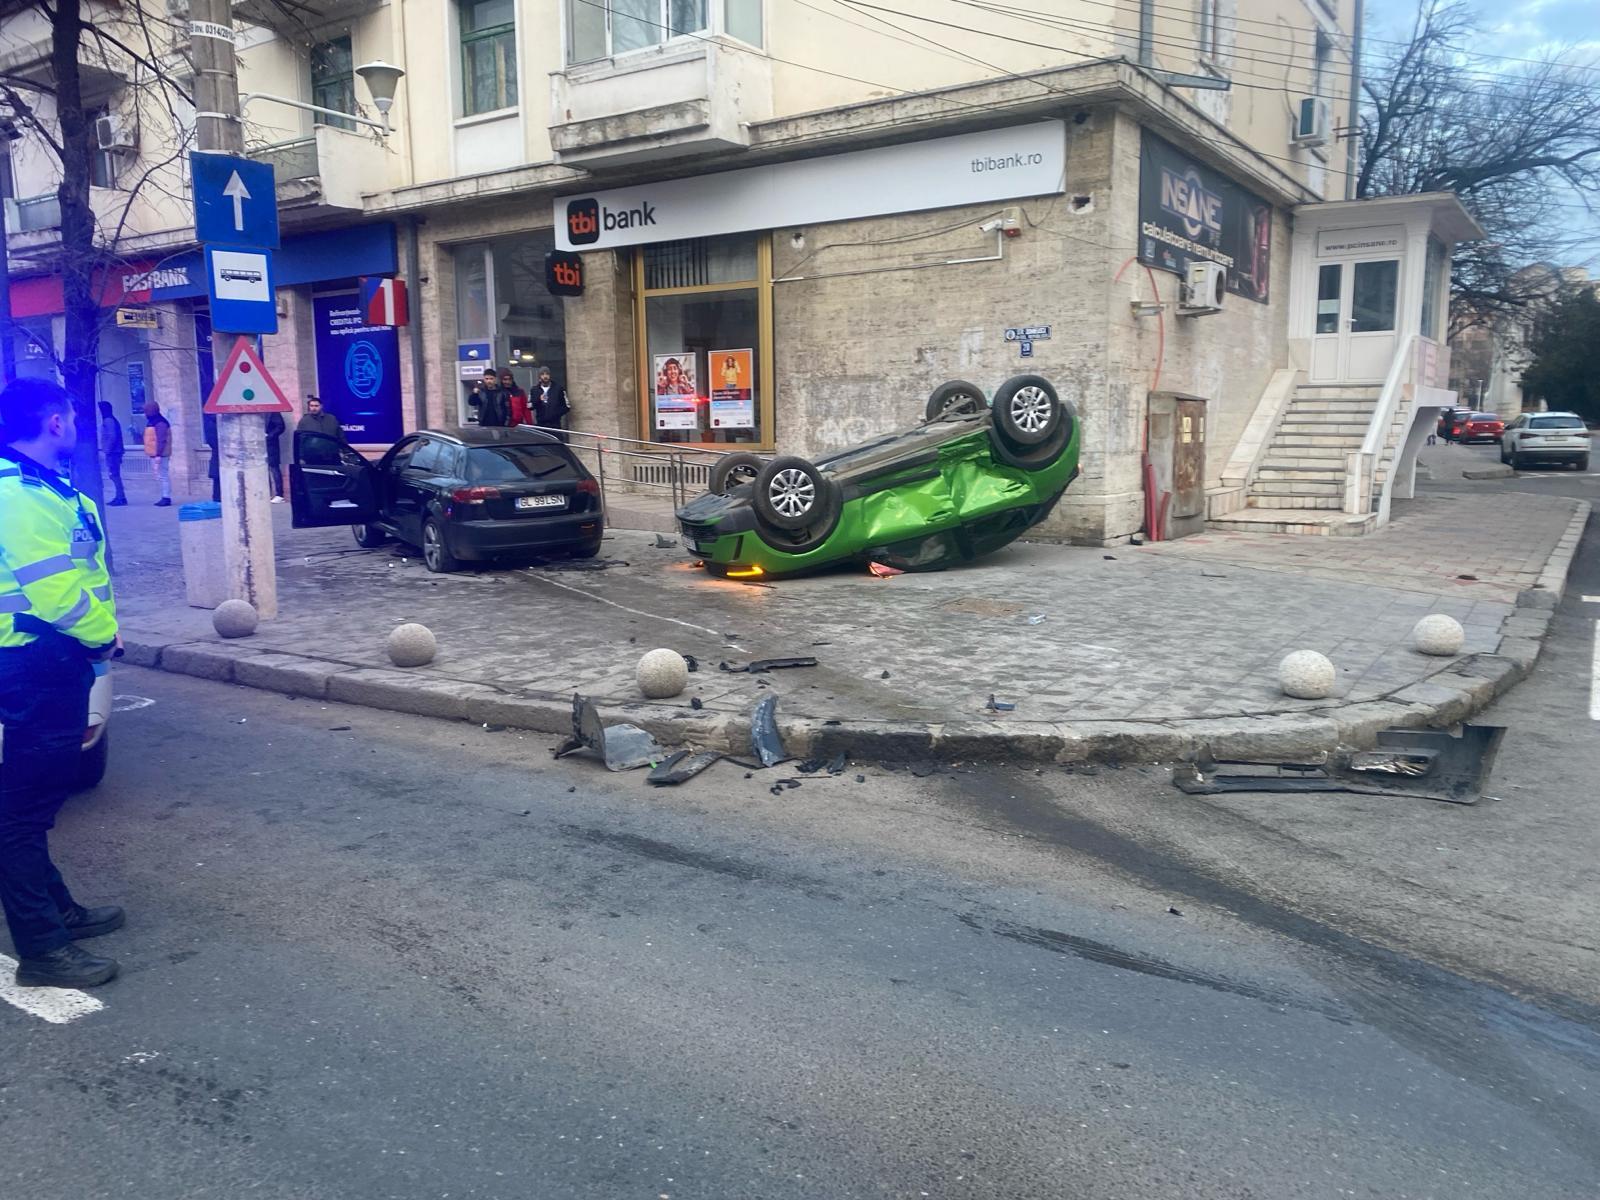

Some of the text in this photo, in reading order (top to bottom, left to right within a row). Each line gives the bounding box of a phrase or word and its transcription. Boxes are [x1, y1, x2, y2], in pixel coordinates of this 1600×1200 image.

[971, 153, 1043, 173] tbibank.ro
[569, 201, 657, 235] tbi bank
[553, 262, 580, 287] tbi
[520, 494, 563, 507] GL 99 LSN
